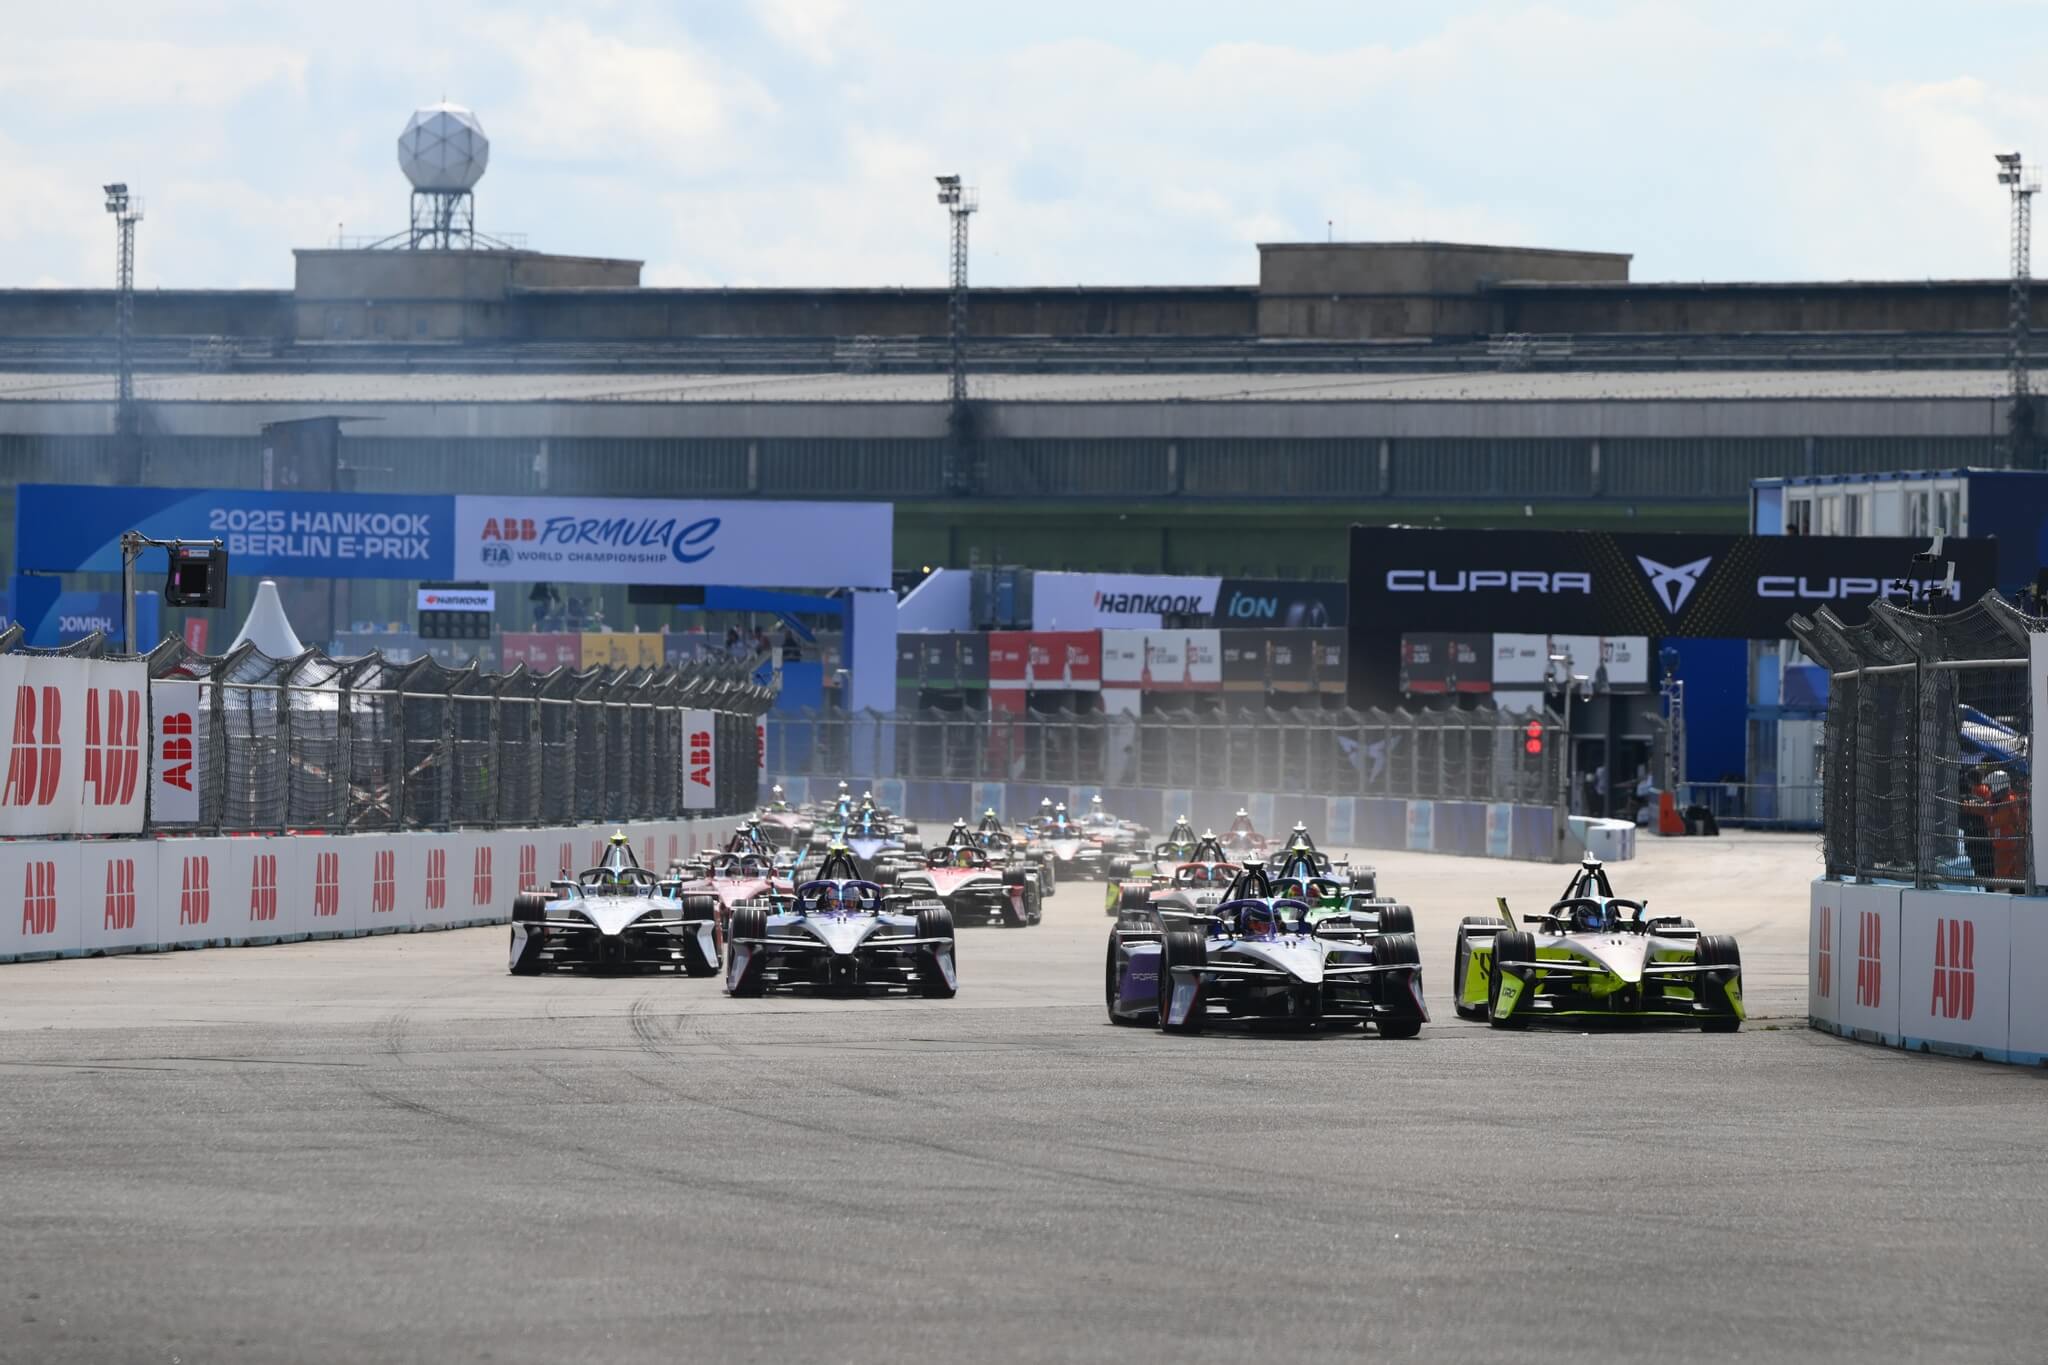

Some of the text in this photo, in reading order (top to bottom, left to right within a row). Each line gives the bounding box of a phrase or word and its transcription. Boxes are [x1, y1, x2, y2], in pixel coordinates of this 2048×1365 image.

[209, 508, 430, 536] 2025 HANKOOK
[229, 534, 430, 560] BERLIN E-PRIX
[481, 517, 537, 541] ABB
[540, 516, 677, 548] FORMULA
[518, 551, 563, 563] WORLD
[568, 552, 668, 564] CHAMPIONSHIP
[1387, 570, 1591, 594] CUPRA
[1757, 576, 1961, 601] CUPRA
[2, 686, 62, 806] ABB
[82, 688, 140, 806] ABB
[162, 712, 193, 792] ABB
[690, 731, 711, 787] ABB
[22, 861, 57, 936] ABB
[104, 858, 136, 930] ABB
[180, 855, 210, 926] ABB
[250, 854, 277, 922] ABB
[314, 852, 339, 917] ABB
[373, 850, 395, 913] ABB
[426, 848, 446, 911] ABB
[473, 846, 492, 906] ABB
[1857, 911, 1881, 1008] ABB
[1931, 918, 1975, 1021] ABB
